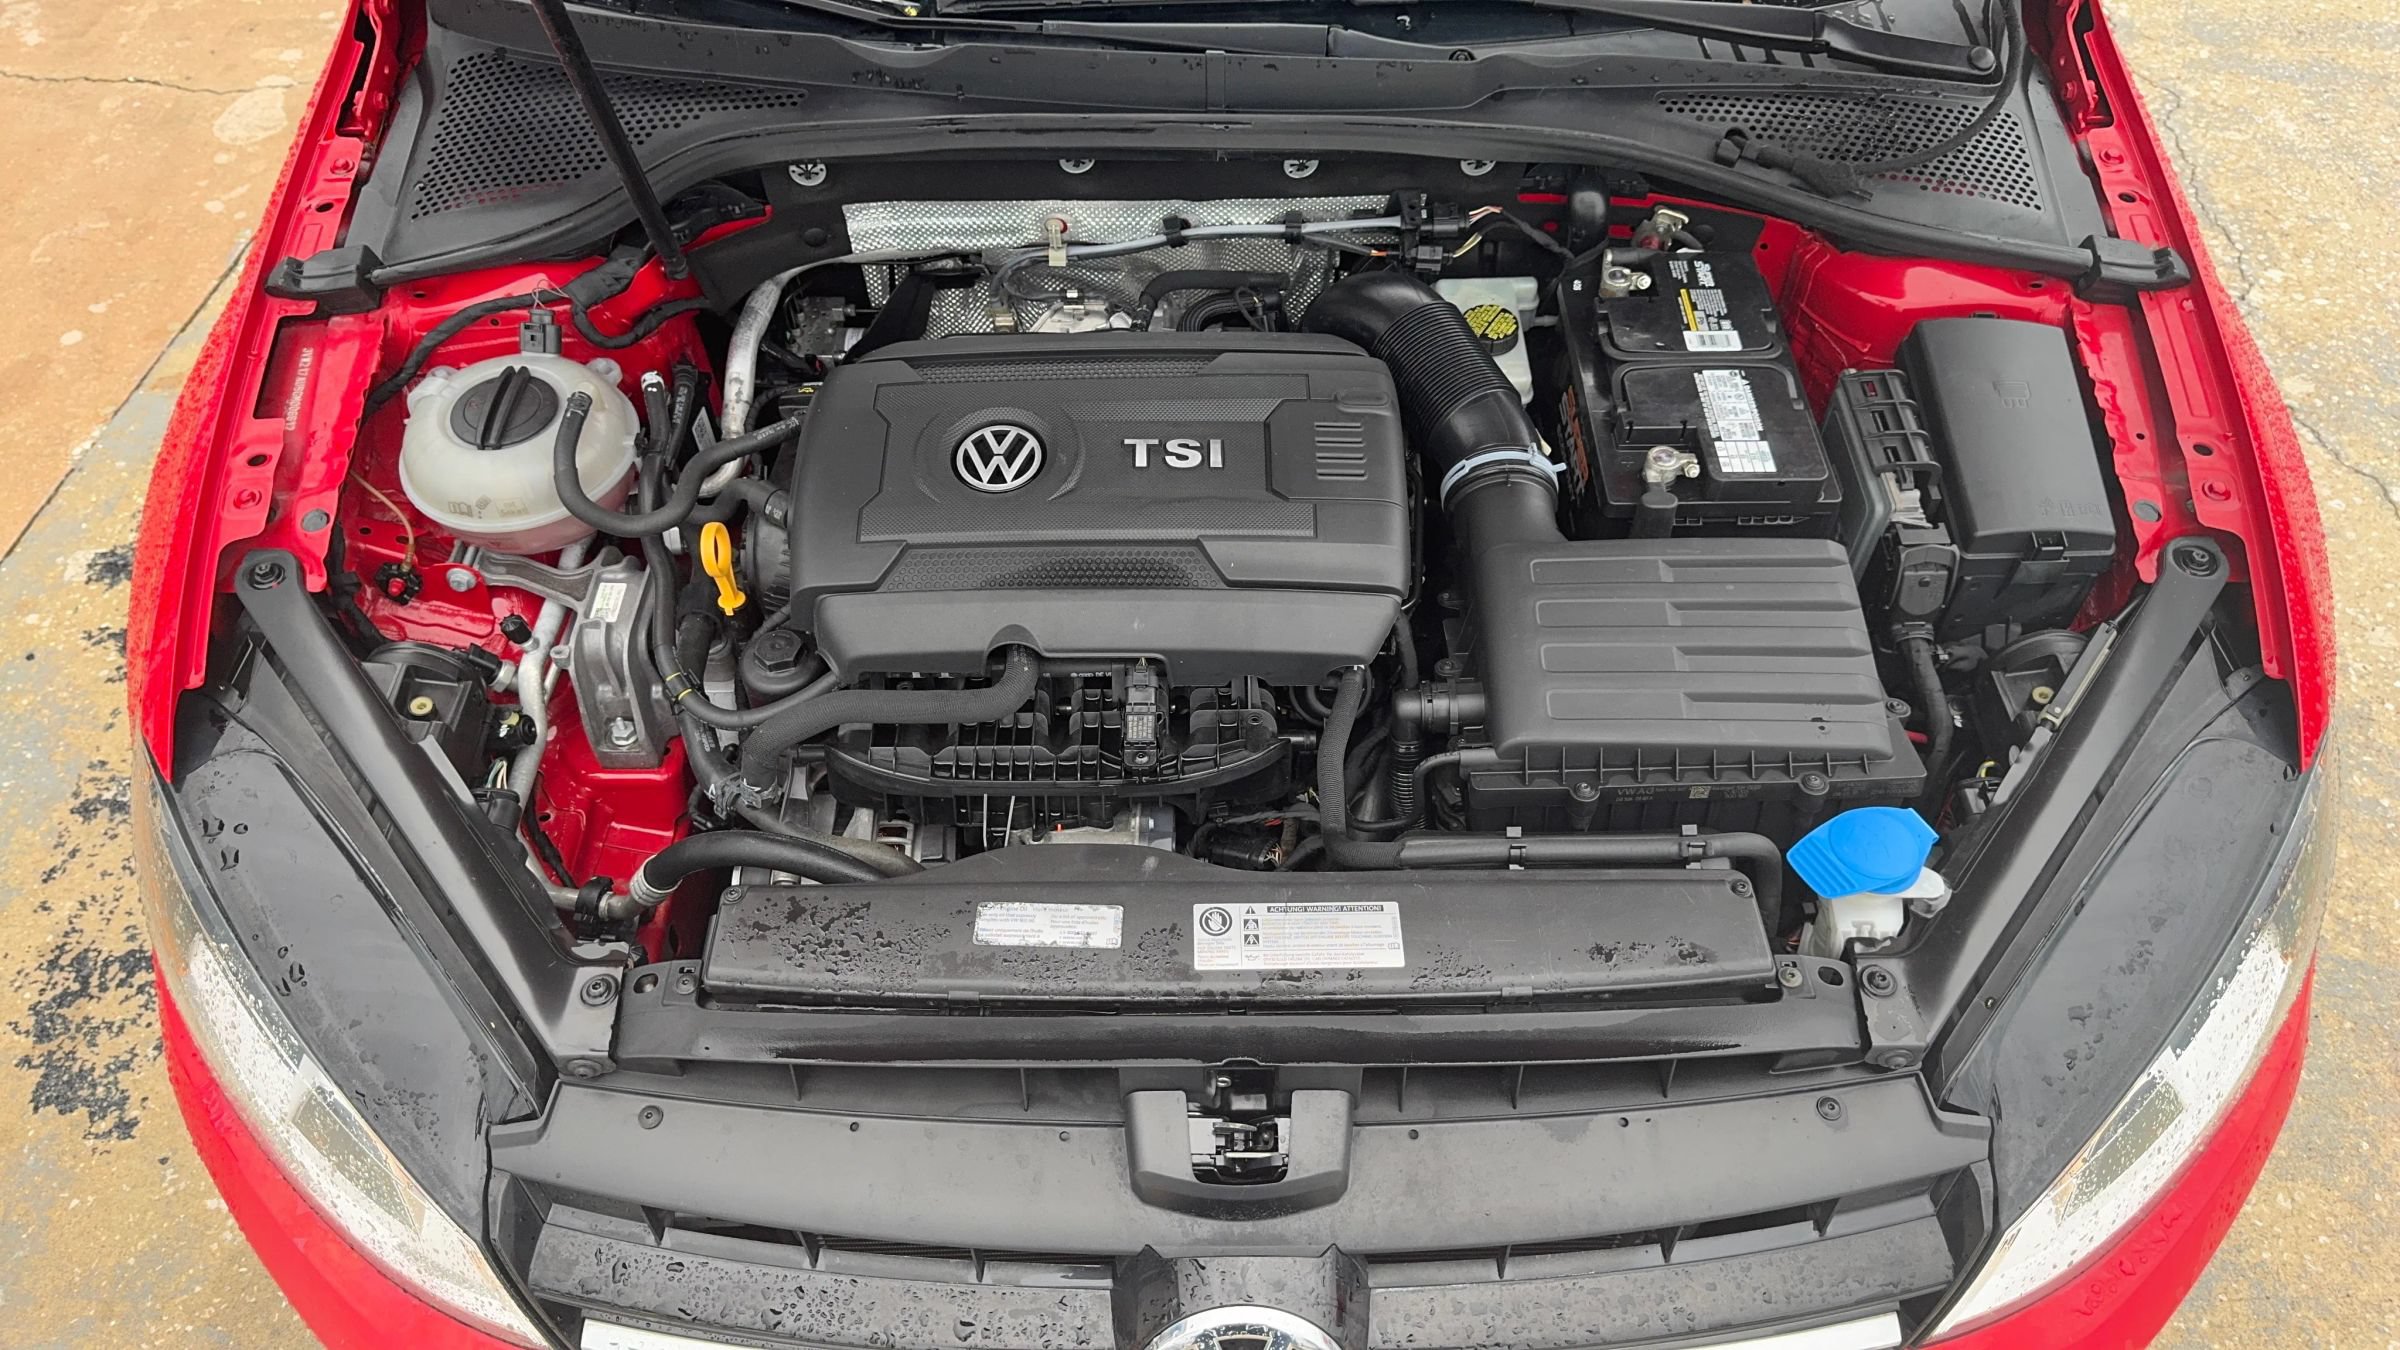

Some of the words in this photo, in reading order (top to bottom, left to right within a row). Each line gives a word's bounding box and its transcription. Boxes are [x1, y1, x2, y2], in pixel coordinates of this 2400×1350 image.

[956, 425, 1042, 491] VW
[1124, 438, 1223, 468] TSI
[1270, 905, 1305, 913] ACHTUNG!
[1306, 905, 1341, 913] WARNING!
[1342, 904, 1382, 912] ATTENTION!
